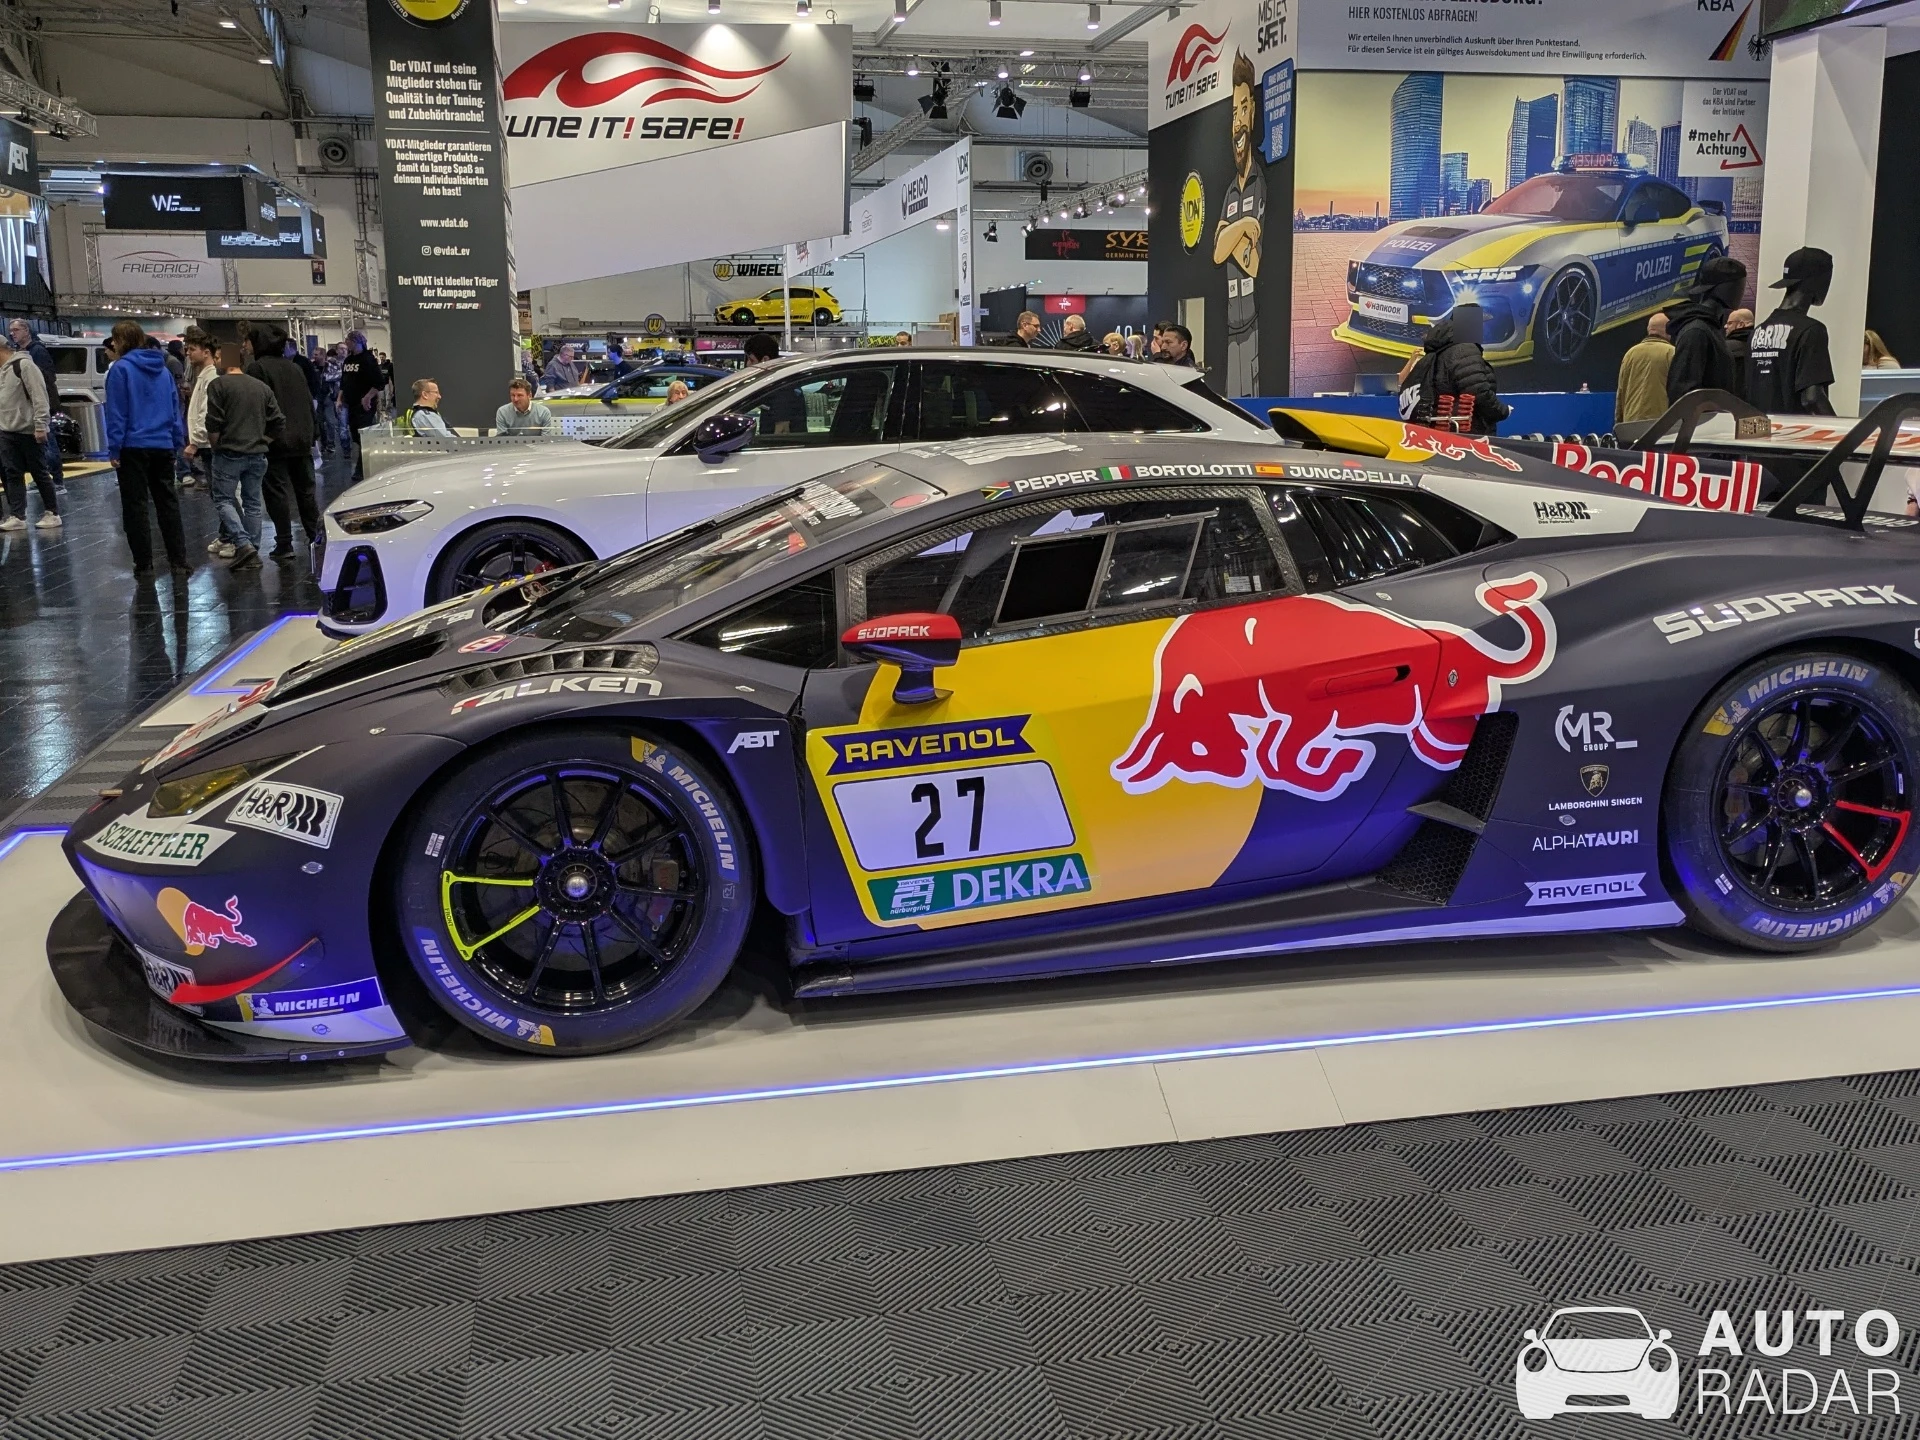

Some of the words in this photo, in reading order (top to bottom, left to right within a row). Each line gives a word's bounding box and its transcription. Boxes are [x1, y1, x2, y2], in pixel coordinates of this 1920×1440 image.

[1348, 7, 1370, 19] HIER
[1373, 8, 1425, 21] KOSTENLOS
[1428, 9, 1478, 22] ABFRAGEN!
[1348, 33, 1361, 42] Wir
[1363, 34, 1391, 42] erteilen
[1392, 34, 1413, 43] Ihnen
[1414, 35, 1463, 44] unverbindlich
[1464, 36, 1496, 45] Auskunft
[1498, 37, 1514, 45] über
[1515, 37, 1534, 46] Ihren
[1535, 37, 1581, 47] Punktestand.
[1348, 45, 1360, 53] Für
[1361, 45, 1385, 54] diesen
[1386, 46, 1412, 54] Service
[1414, 46, 1423, 55] ist
[1424, 47, 1435, 55] ein
[1436, 47, 1464, 57] gültiges
[1465, 48, 1530, 58] Ausweisdokument
[1532, 50, 1545, 58] und
[1546, 50, 1561, 58] Ihre
[1562, 50, 1603, 60] Einwilligung
[1604, 52, 1647, 60] erforderlich.
[389, 60, 406, 72] Der
[407, 61, 432, 73] VDAT
[433, 62, 451, 74] und
[452, 63, 477, 75] seine
[386, 75, 434, 90] Mitglieder
[435, 77, 467, 90] stehen
[468, 79, 482, 91] für
[385, 91, 423, 105] Qualität
[425, 93, 435, 105] in
[435, 93, 452, 106] der
[452, 94, 486, 108] Tuning-
[1712, 88, 1722, 96] Der
[1702, 97, 1711, 105] das
[1724, 98, 1736, 106] sind
[1736, 98, 1756, 106] Partner
[388, 108, 406, 119] und
[407, 108, 484, 122] Zubehörbranche!
[505, 116, 583, 139] UNE
[1688, 129, 1731, 142] #mehr
[385, 139, 446, 151] VDAT-Mitglieder
[447, 141, 492, 152] garantieren
[1696, 143, 1747, 158] Achtung
[7, 141, 29, 175] ABT
[395, 151, 442, 163] hochwertige
[443, 152, 478, 163] Produkte
[396, 162, 419, 173] damit
[420, 163, 430, 173] du
[431, 163, 452, 174] lange
[453, 164, 473, 175] Spaß
[474, 166, 484, 174] an
[393, 174, 421, 184] deinem
[422, 174, 489, 186] individualisierten
[422, 186, 441, 196] Auto
[442, 186, 462, 196] hast!
[907, 174, 929, 203] HEICO
[420, 218, 469, 228] www.vdat.de
[1383, 239, 1437, 252] POLIZEI
[122, 263, 200, 273] FRIEDRICH
[1635, 255, 1673, 282] POLIZEI
[398, 275, 412, 285] Der
[412, 276, 433, 286] VDAT
[433, 276, 444, 286] ist
[445, 277, 473, 286] ideeller
[474, 277, 499, 288] Träger
[423, 287, 436, 297] der
[436, 288, 476, 299] Kampagne
[1015, 469, 1100, 493] PEPPER
[1135, 464, 1253, 479] BORTOLOTTI
[1289, 465, 1414, 487] JUNCADELLA
[1553, 442, 1656, 495] Red
[1661, 453, 1763, 514] Bull
[1653, 585, 1918, 645] SÜDPACK
[857, 625, 930, 639] SÜDPACK
[1748, 661, 1869, 703] MICHELIN
[450, 676, 663, 716] FALKEN
[727, 730, 780, 754] ABT
[844, 728, 1015, 763] RAVENOL
[1583, 743, 1609, 752] GROUP
[1548, 799, 1609, 811] LAMBORGHINI
[1611, 797, 1643, 806] SINGEN
[668, 765, 736, 872] MICHELIN
[911, 776, 985, 859] 27
[97, 821, 211, 860] SCHAEFFLER
[1532, 830, 1639, 852] ALPHATAURI
[952, 857, 1085, 908] DEKRA
[1538, 881, 1635, 899] RAVENOL
[890, 904, 931, 915] nürburgring
[1753, 901, 1873, 938] MICHELIN
[420, 938, 513, 1030] MICHELIN
[275, 992, 360, 1012] MICHELIN
